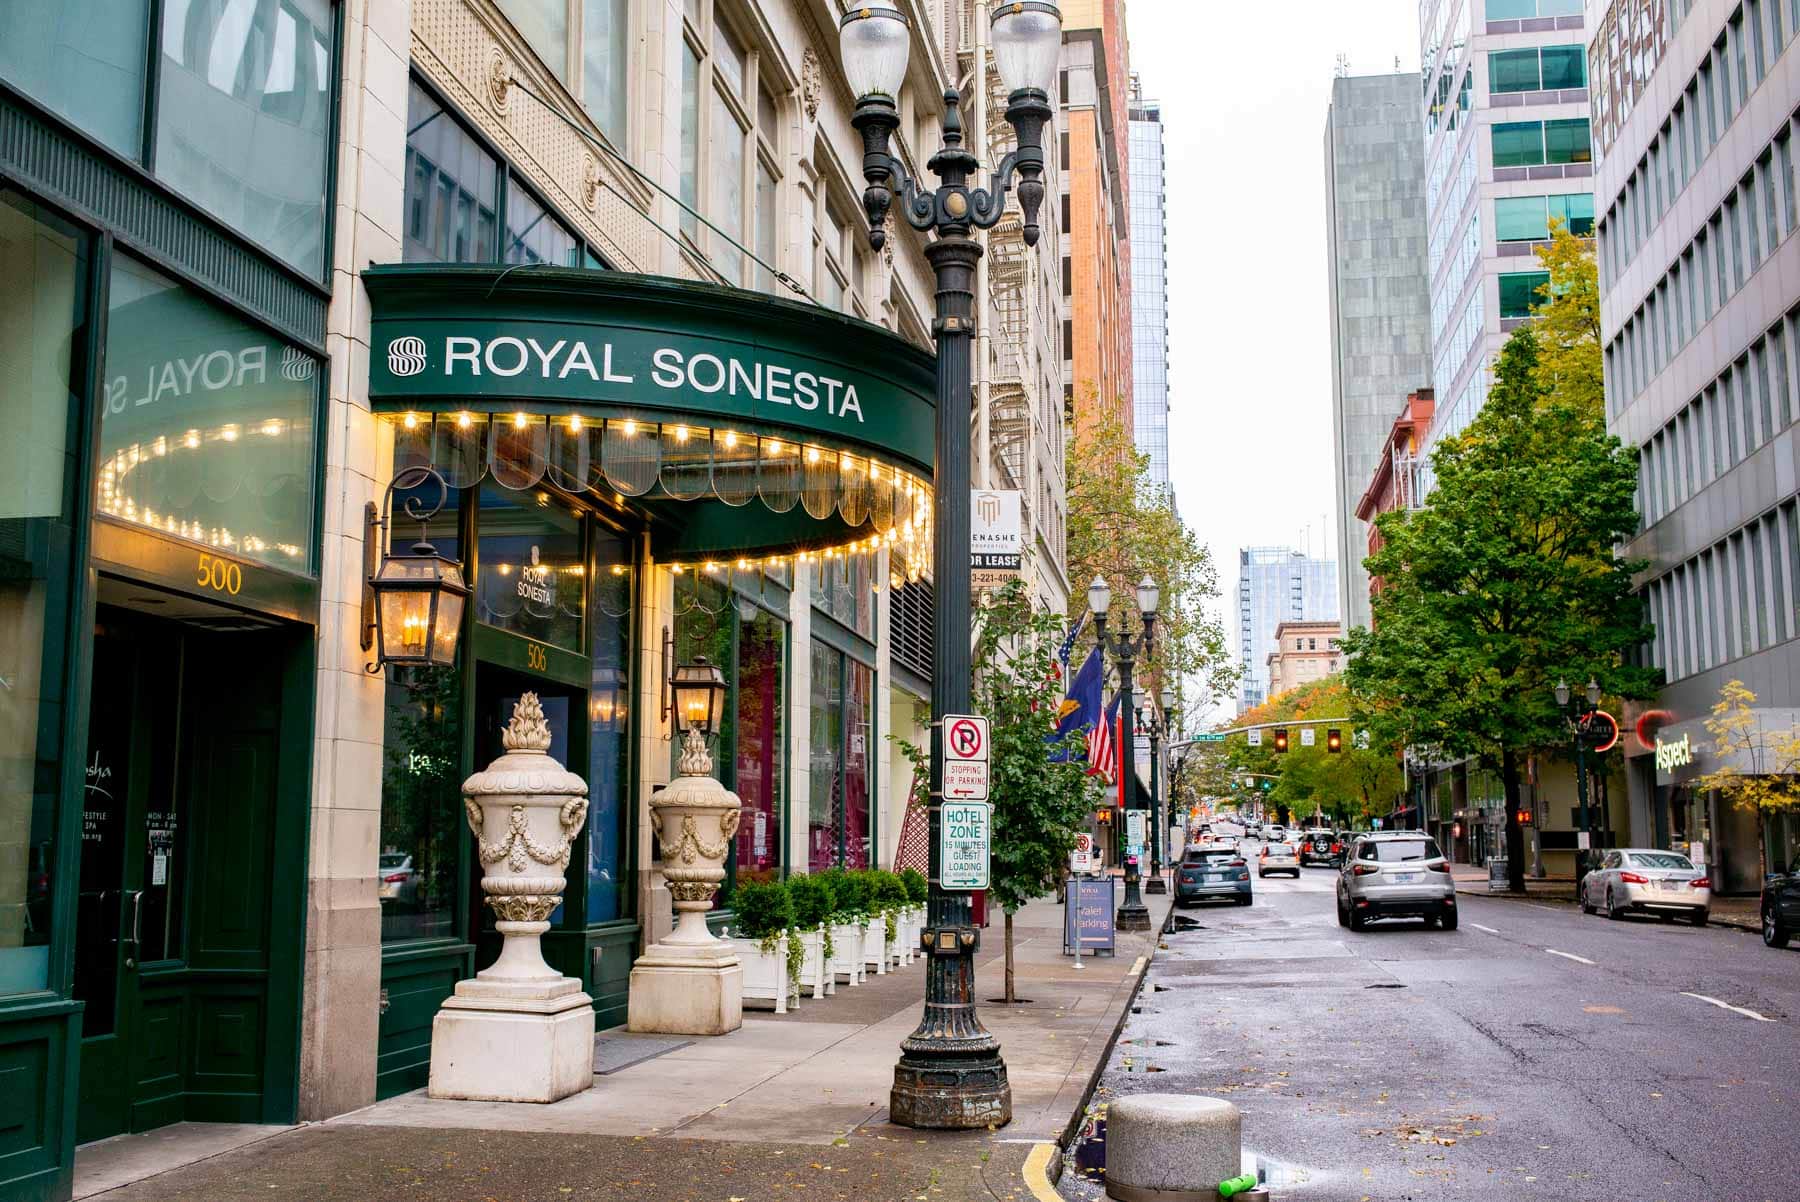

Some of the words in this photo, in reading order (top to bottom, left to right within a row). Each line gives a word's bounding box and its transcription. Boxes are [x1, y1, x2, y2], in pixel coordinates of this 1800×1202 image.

[445, 336, 634, 384] ROYAL
[651, 348, 864, 423] SONESTA
[972, 534, 1016, 542] ENASHE
[986, 555, 1017, 566] LEASE
[197, 554, 242, 594] 500
[523, 566, 546, 587] ROYAL
[518, 581, 551, 606] SONESTA
[528, 643, 547, 671] 506
[1656, 733, 1690, 774] Aspect
[951, 765, 982, 775] STOPPING
[945, 776, 955, 785] OR
[958, 776, 986, 785] PARKING
[947, 810, 985, 824] HOTEL
[950, 825, 982, 839] ZONE
[945, 841, 953, 849] 15
[954, 841, 986, 850] MINUTES
[953, 851, 978, 860] GUEST
[948, 862, 982, 871] LOADING
